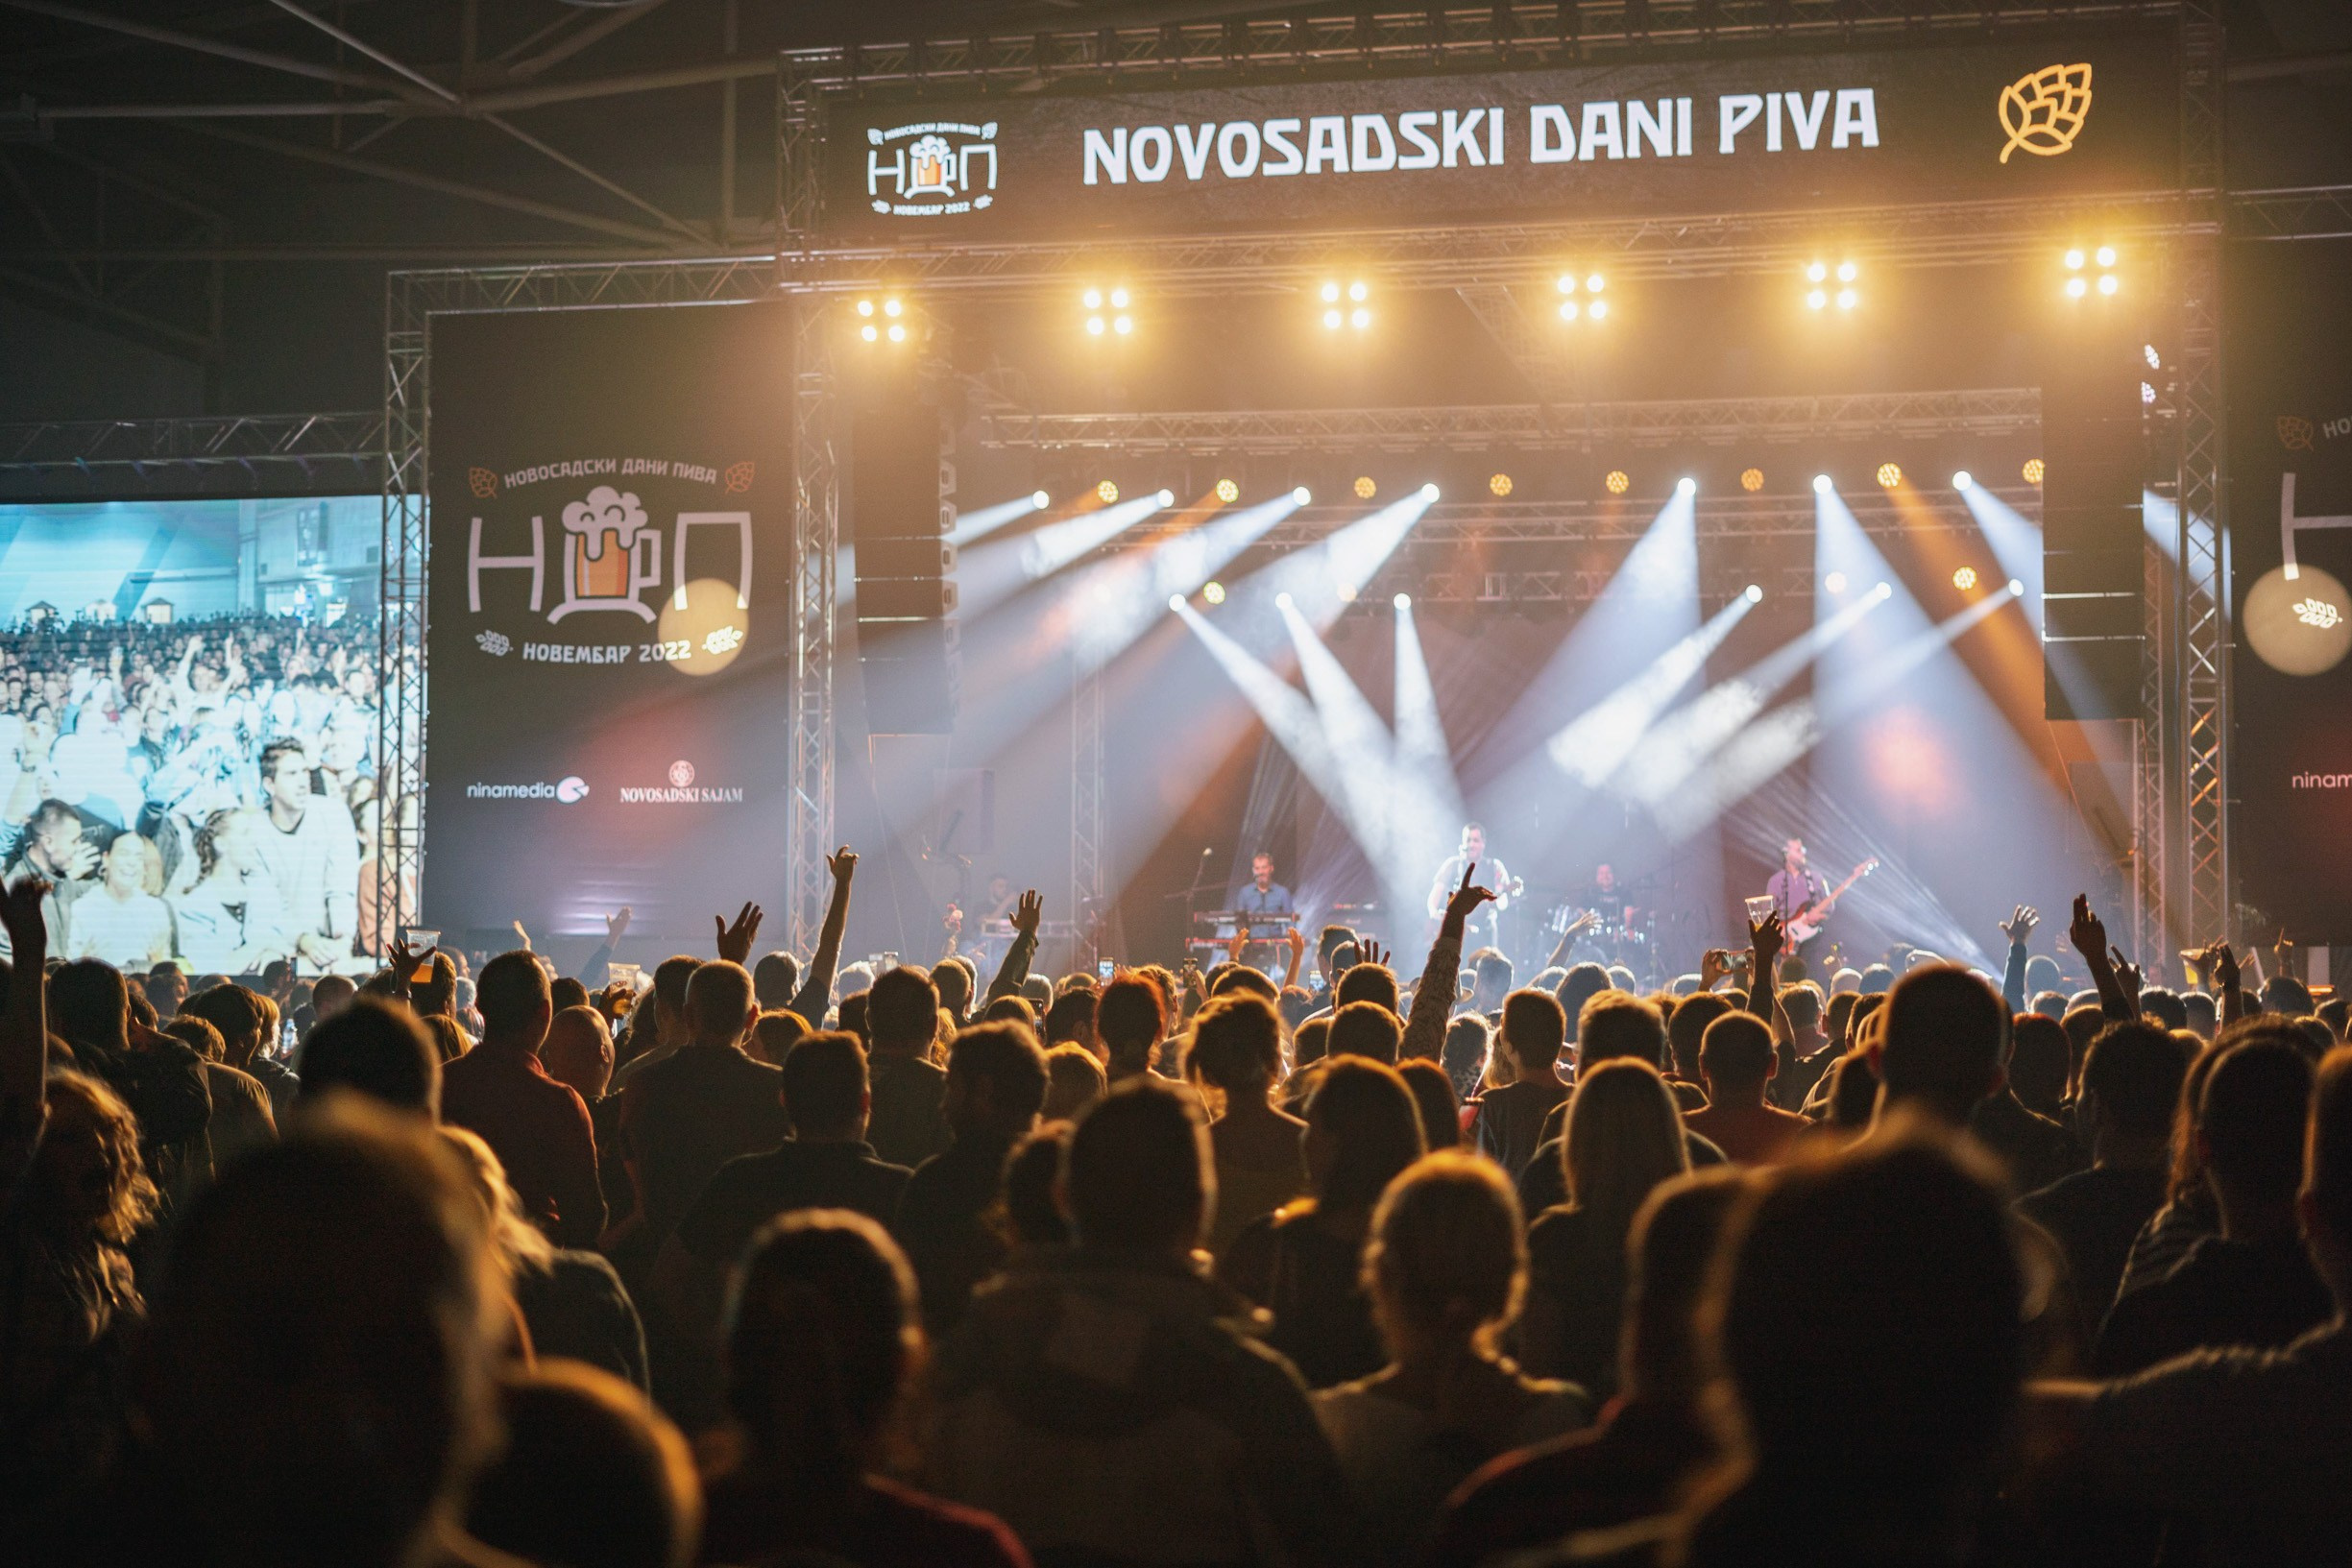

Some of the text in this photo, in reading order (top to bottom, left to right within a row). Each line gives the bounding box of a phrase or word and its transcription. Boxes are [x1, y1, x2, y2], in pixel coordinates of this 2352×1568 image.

[1083, 88, 1879, 184] NOVOSADSKI DANI PIVA
[504, 458, 717, 489] НОВОСАДСКИ ДАНИ ПИВА
[522, 639, 691, 663] НОВЕМБАР 2022
[2292, 771, 2352, 788] ninam
[467, 782, 555, 799] ninamedia
[619, 787, 743, 803] NOVOSADSKI SAJAM
